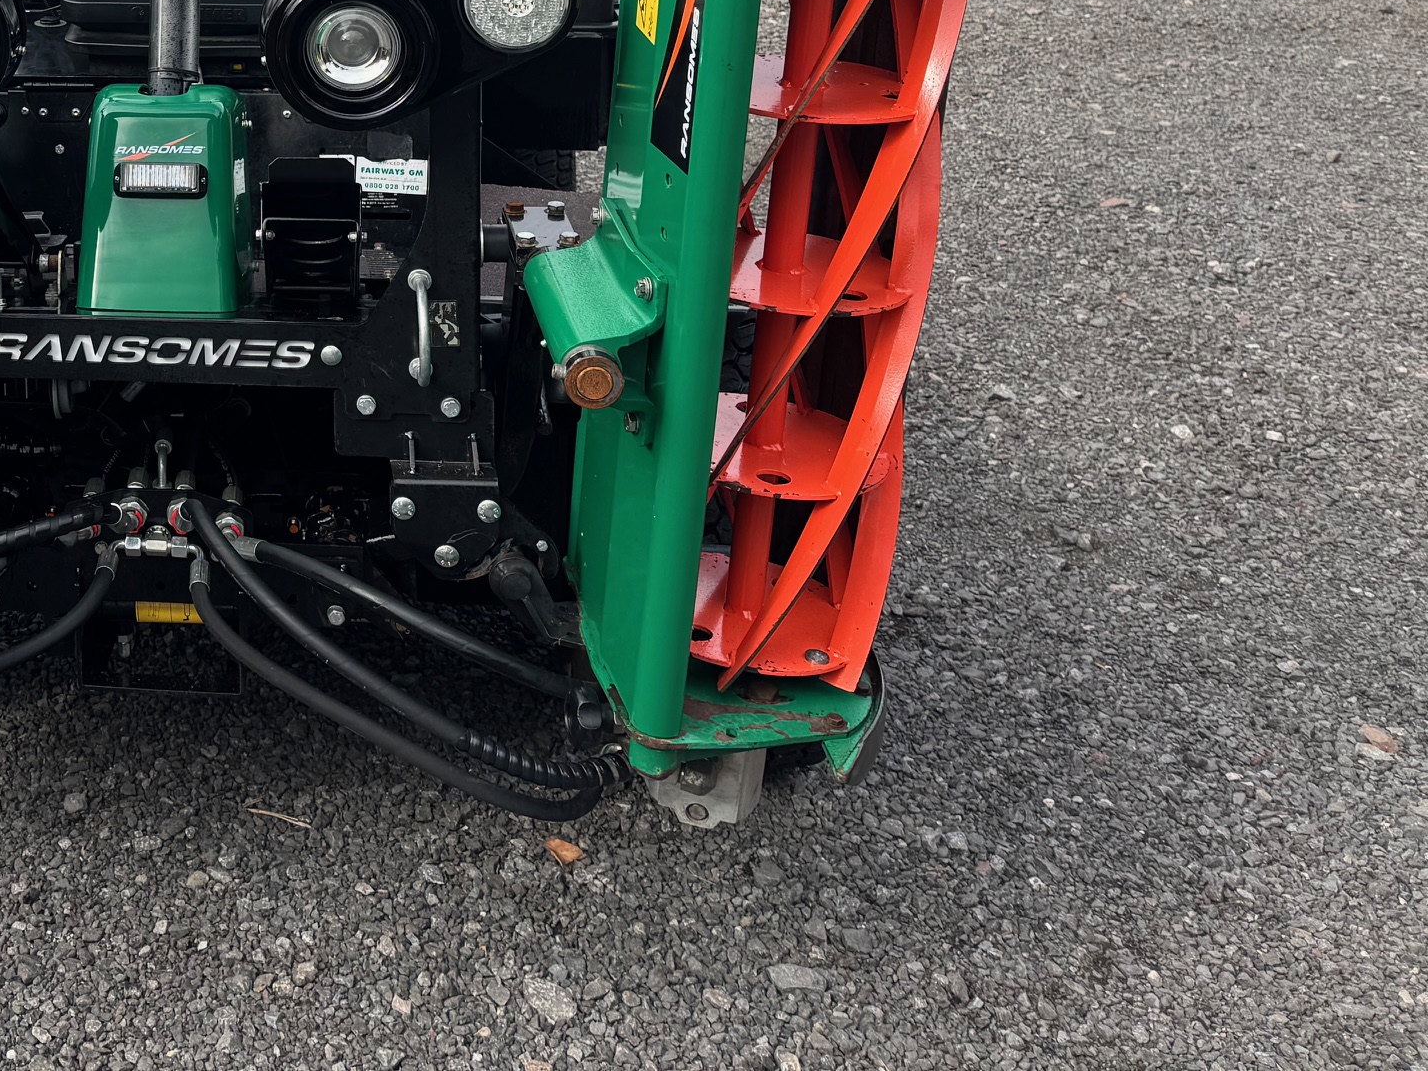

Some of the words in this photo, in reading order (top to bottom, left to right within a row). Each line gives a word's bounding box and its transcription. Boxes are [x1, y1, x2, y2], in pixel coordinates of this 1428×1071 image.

[680, 6, 700, 159] RANSOMES
[115, 145, 204, 155] RANSOMES
[361, 167, 405, 176] FAIRWAYS
[408, 169, 424, 177] GM
